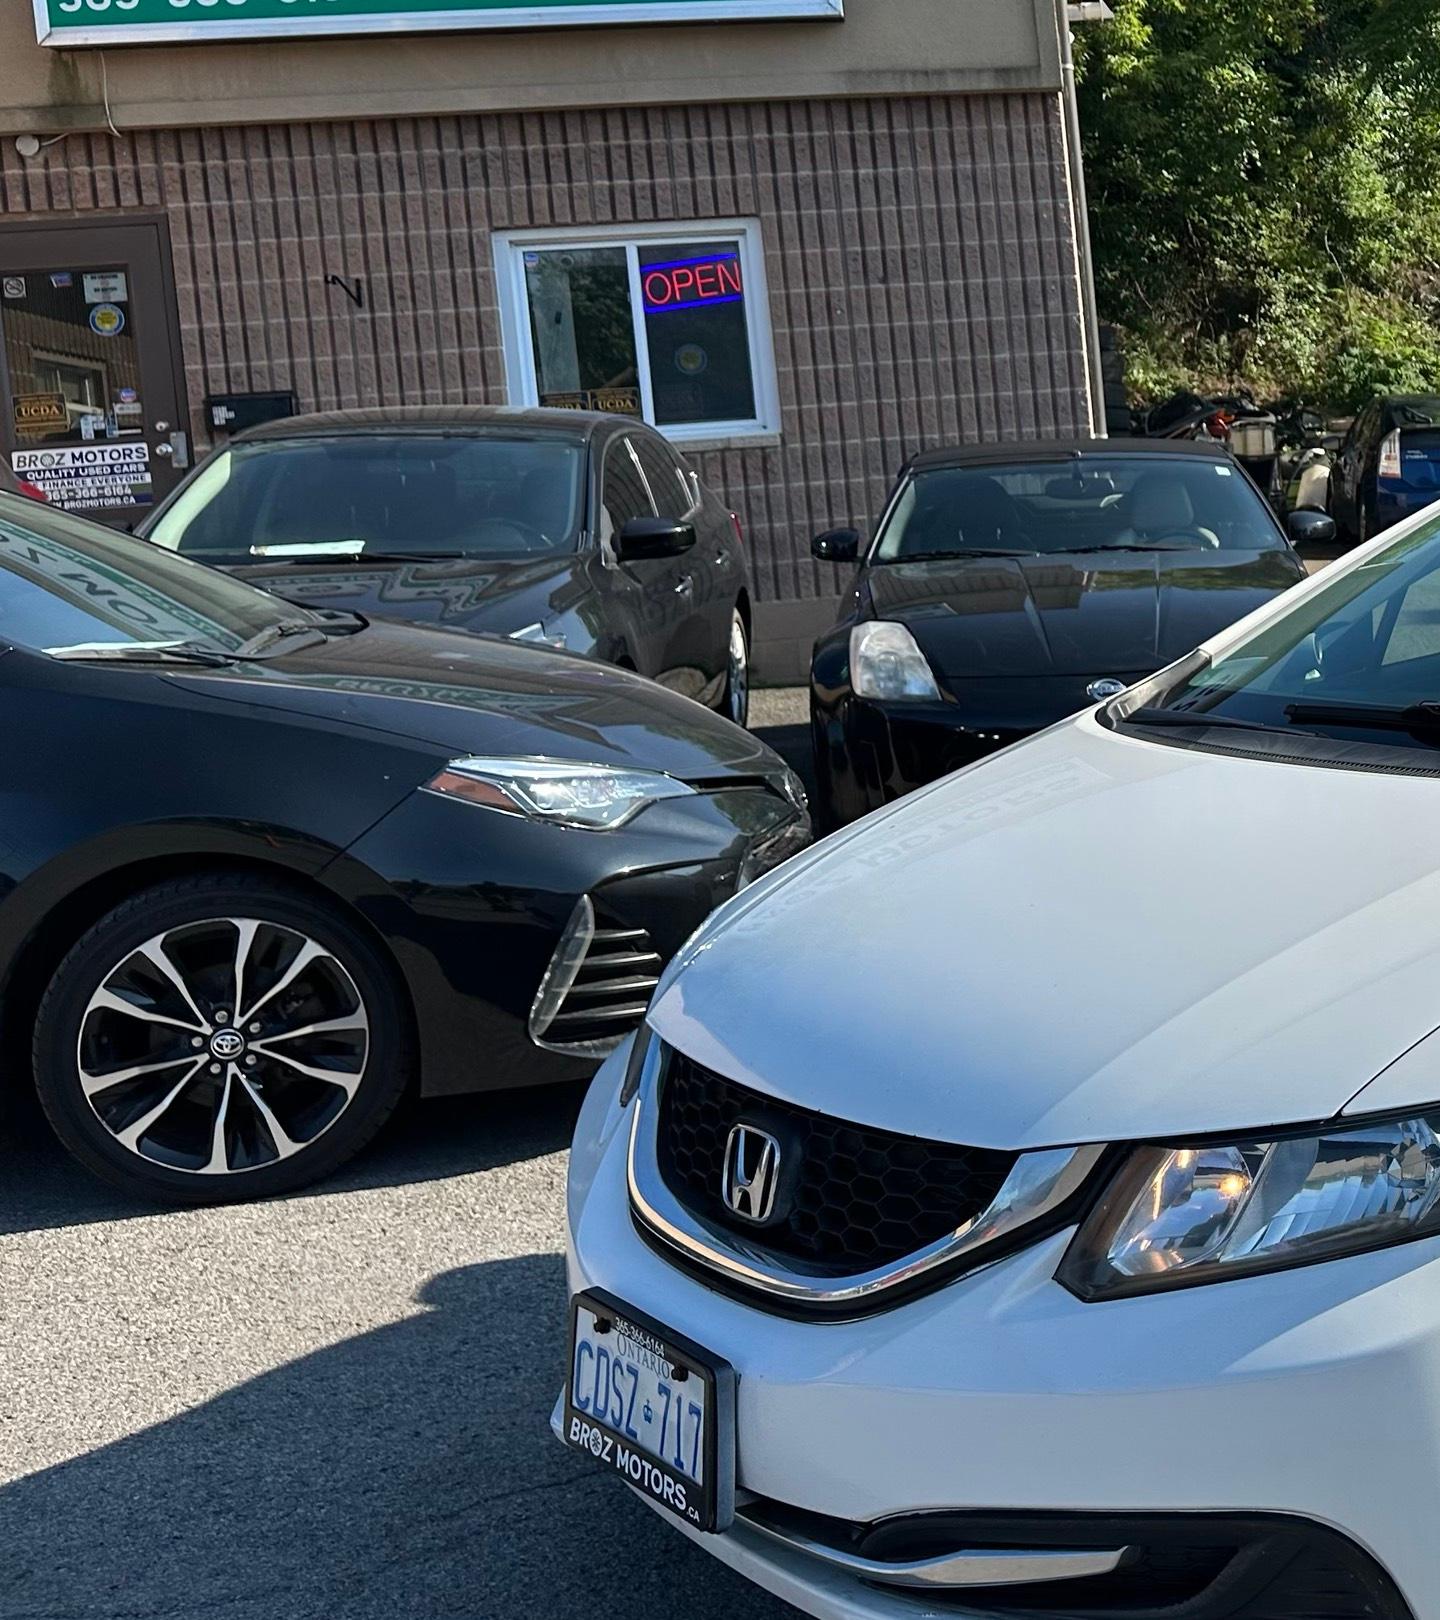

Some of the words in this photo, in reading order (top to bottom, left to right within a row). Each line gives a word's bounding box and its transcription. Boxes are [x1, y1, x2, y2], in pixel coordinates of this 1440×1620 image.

[645, 261, 742, 305] OPEN
[20, 405, 60, 417] UCDA
[597, 399, 634, 410] UCDA
[16, 453, 66, 469] BROZ
[71, 446, 147, 464] MOTORS
[26, 468, 76, 481] QUALITY
[79, 466, 111, 477] USED
[114, 463, 146, 474] CARS
[43, 478, 88, 490] FINANCE
[91, 474, 146, 487] EVERYONE
[615, 1316, 665, 1358] 365-366-6164
[617, 1332, 671, 1379] ONTARIO
[574, 1340, 639, 1441] CDSZ
[657, 1381, 702, 1479] 717
[569, 1416, 612, 1464] BROZ
